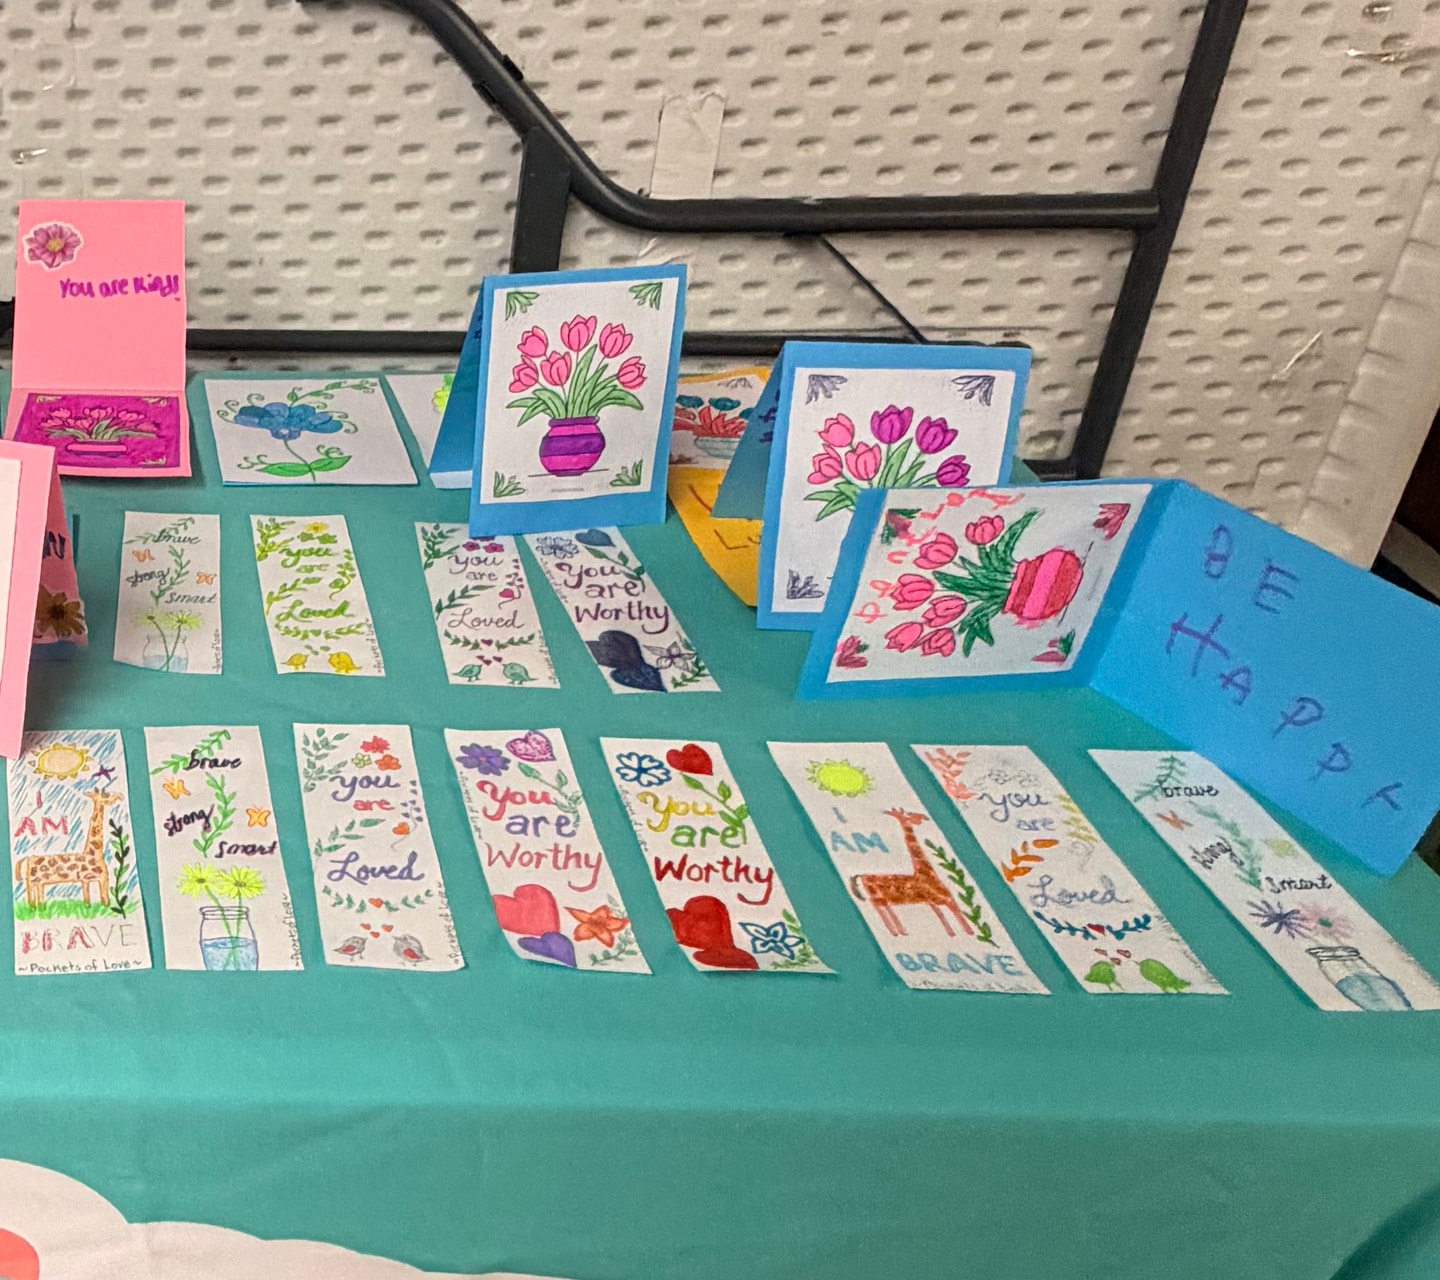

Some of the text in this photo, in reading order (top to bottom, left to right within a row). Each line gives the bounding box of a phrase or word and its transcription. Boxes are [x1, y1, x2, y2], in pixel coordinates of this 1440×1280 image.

[60, 277, 95, 299] You
[99, 278, 129, 298] are
[156, 528, 201, 545] brave
[279, 547, 339, 569] you
[296, 563, 330, 574] are
[448, 554, 504, 575] you
[1204, 524, 1300, 615] BE
[465, 571, 499, 582] are
[555, 562, 623, 589] You
[584, 580, 641, 599] are
[275, 599, 356, 623] Loved
[447, 607, 525, 630] Loved
[574, 601, 669, 635] Worthy
[1165, 612, 1403, 813] HAPPY
[185, 749, 242, 770] brave
[329, 774, 401, 802] you
[353, 800, 395, 811] are
[476, 780, 556, 821] You
[637, 791, 716, 832] You
[978, 792, 1051, 822] you
[14, 815, 68, 838] AM
[163, 804, 215, 837] strong
[505, 814, 577, 838] are
[1016, 819, 1055, 831] are
[670, 825, 741, 848] are
[830, 831, 889, 854] AM
[327, 851, 425, 885] Loved
[486, 842, 602, 892] Worthy
[654, 853, 774, 905] Worthy
[1028, 874, 1133, 907] Loved
[21, 923, 138, 954] BRAVE
[895, 952, 1027, 976] BRAVE
